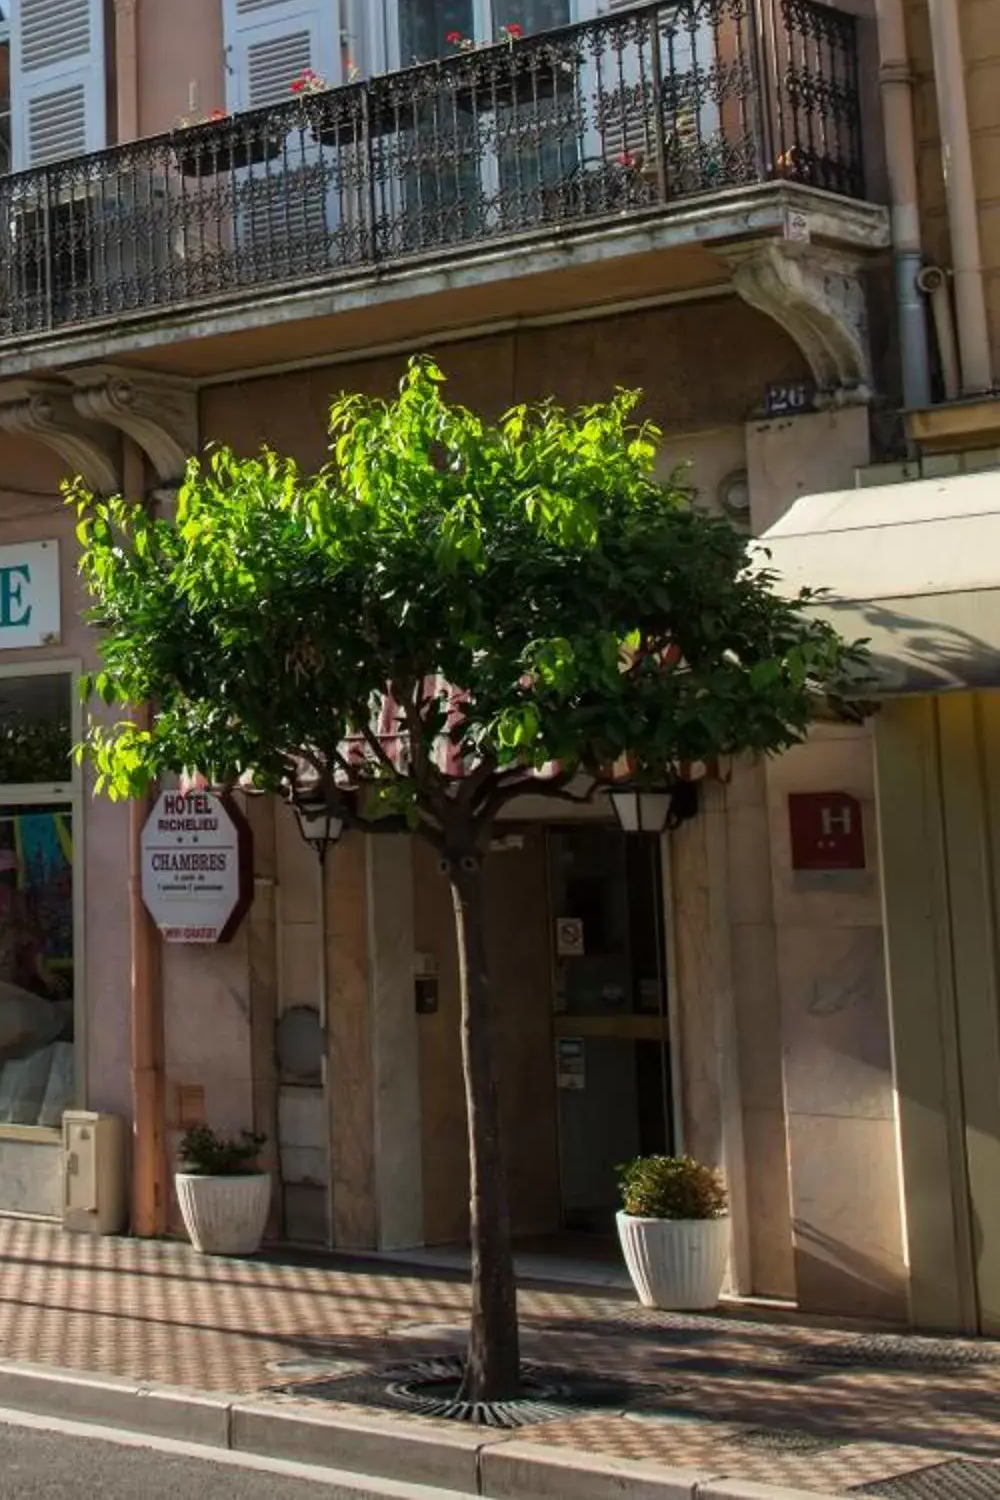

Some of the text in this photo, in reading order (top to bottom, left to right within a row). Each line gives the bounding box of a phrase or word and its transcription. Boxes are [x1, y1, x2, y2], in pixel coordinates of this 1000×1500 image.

[770, 386, 805, 411] 26
[164, 795, 213, 814] HOTEL
[158, 818, 218, 831] RICHELIEU
[822, 806, 851, 835] H
[151, 853, 227, 872] CHAMBRES
